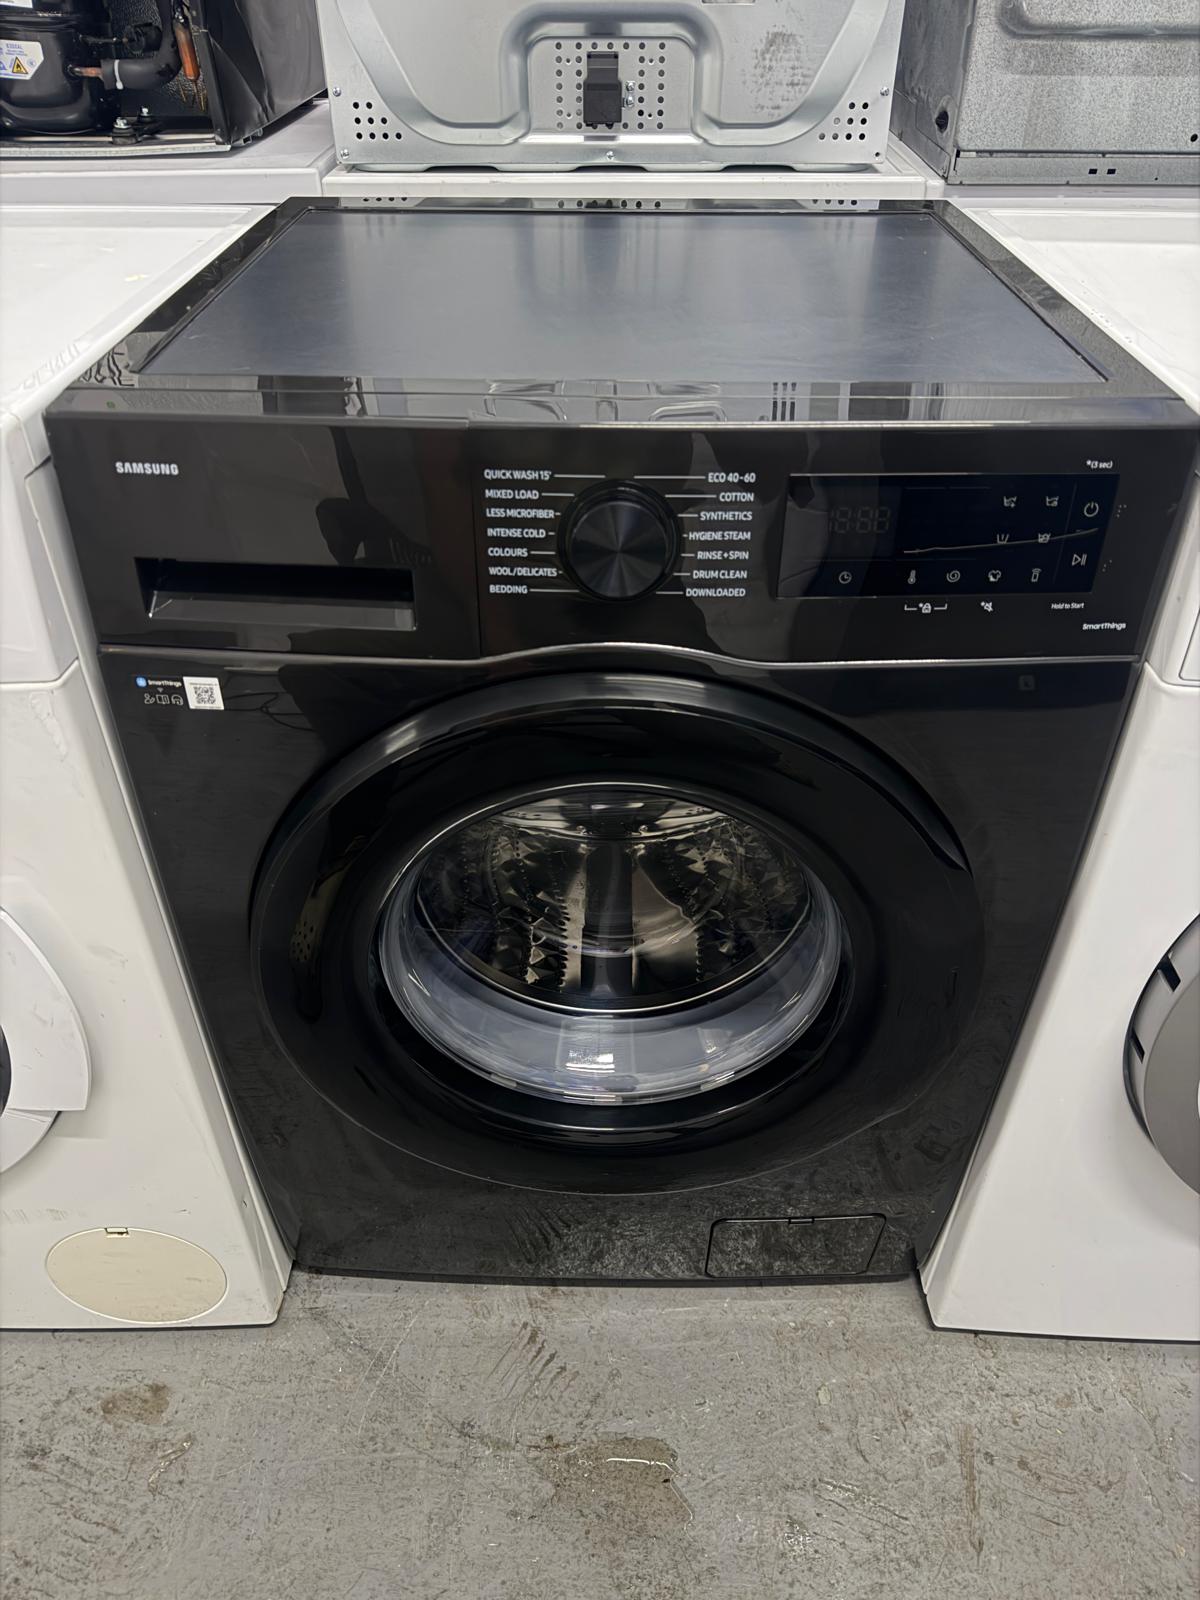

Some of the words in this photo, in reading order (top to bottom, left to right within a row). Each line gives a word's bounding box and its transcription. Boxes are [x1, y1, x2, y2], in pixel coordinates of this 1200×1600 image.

[115, 461, 179, 476] SAMSUNG
[484, 469, 512, 480] QUICK
[512, 470, 539, 480] WASH
[708, 472, 726, 483] ECO
[727, 472, 756, 483] 40-60
[485, 489, 514, 499] MIXED
[515, 490, 539, 500] LOAD
[719, 492, 754, 502] COTTON
[486, 508, 506, 518] LESS
[506, 509, 555, 519] MICROFIBER
[700, 511, 753, 521] SYNTHETICS
[487, 528, 522, 537] INTENSE
[523, 528, 546, 538] COLD
[688, 531, 724, 541] HYGIENE
[724, 531, 751, 541] STEAM
[488, 547, 528, 557] COLOURS
[488, 567, 558, 577] WOOL/DELICATES
[692, 570, 719, 579] DRUM
[719, 570, 748, 579] CLEAN
[489, 584, 528, 594] BEDDING
[685, 587, 746, 597] DOWNLOADED
[1082, 622, 1127, 631] SmartThings
